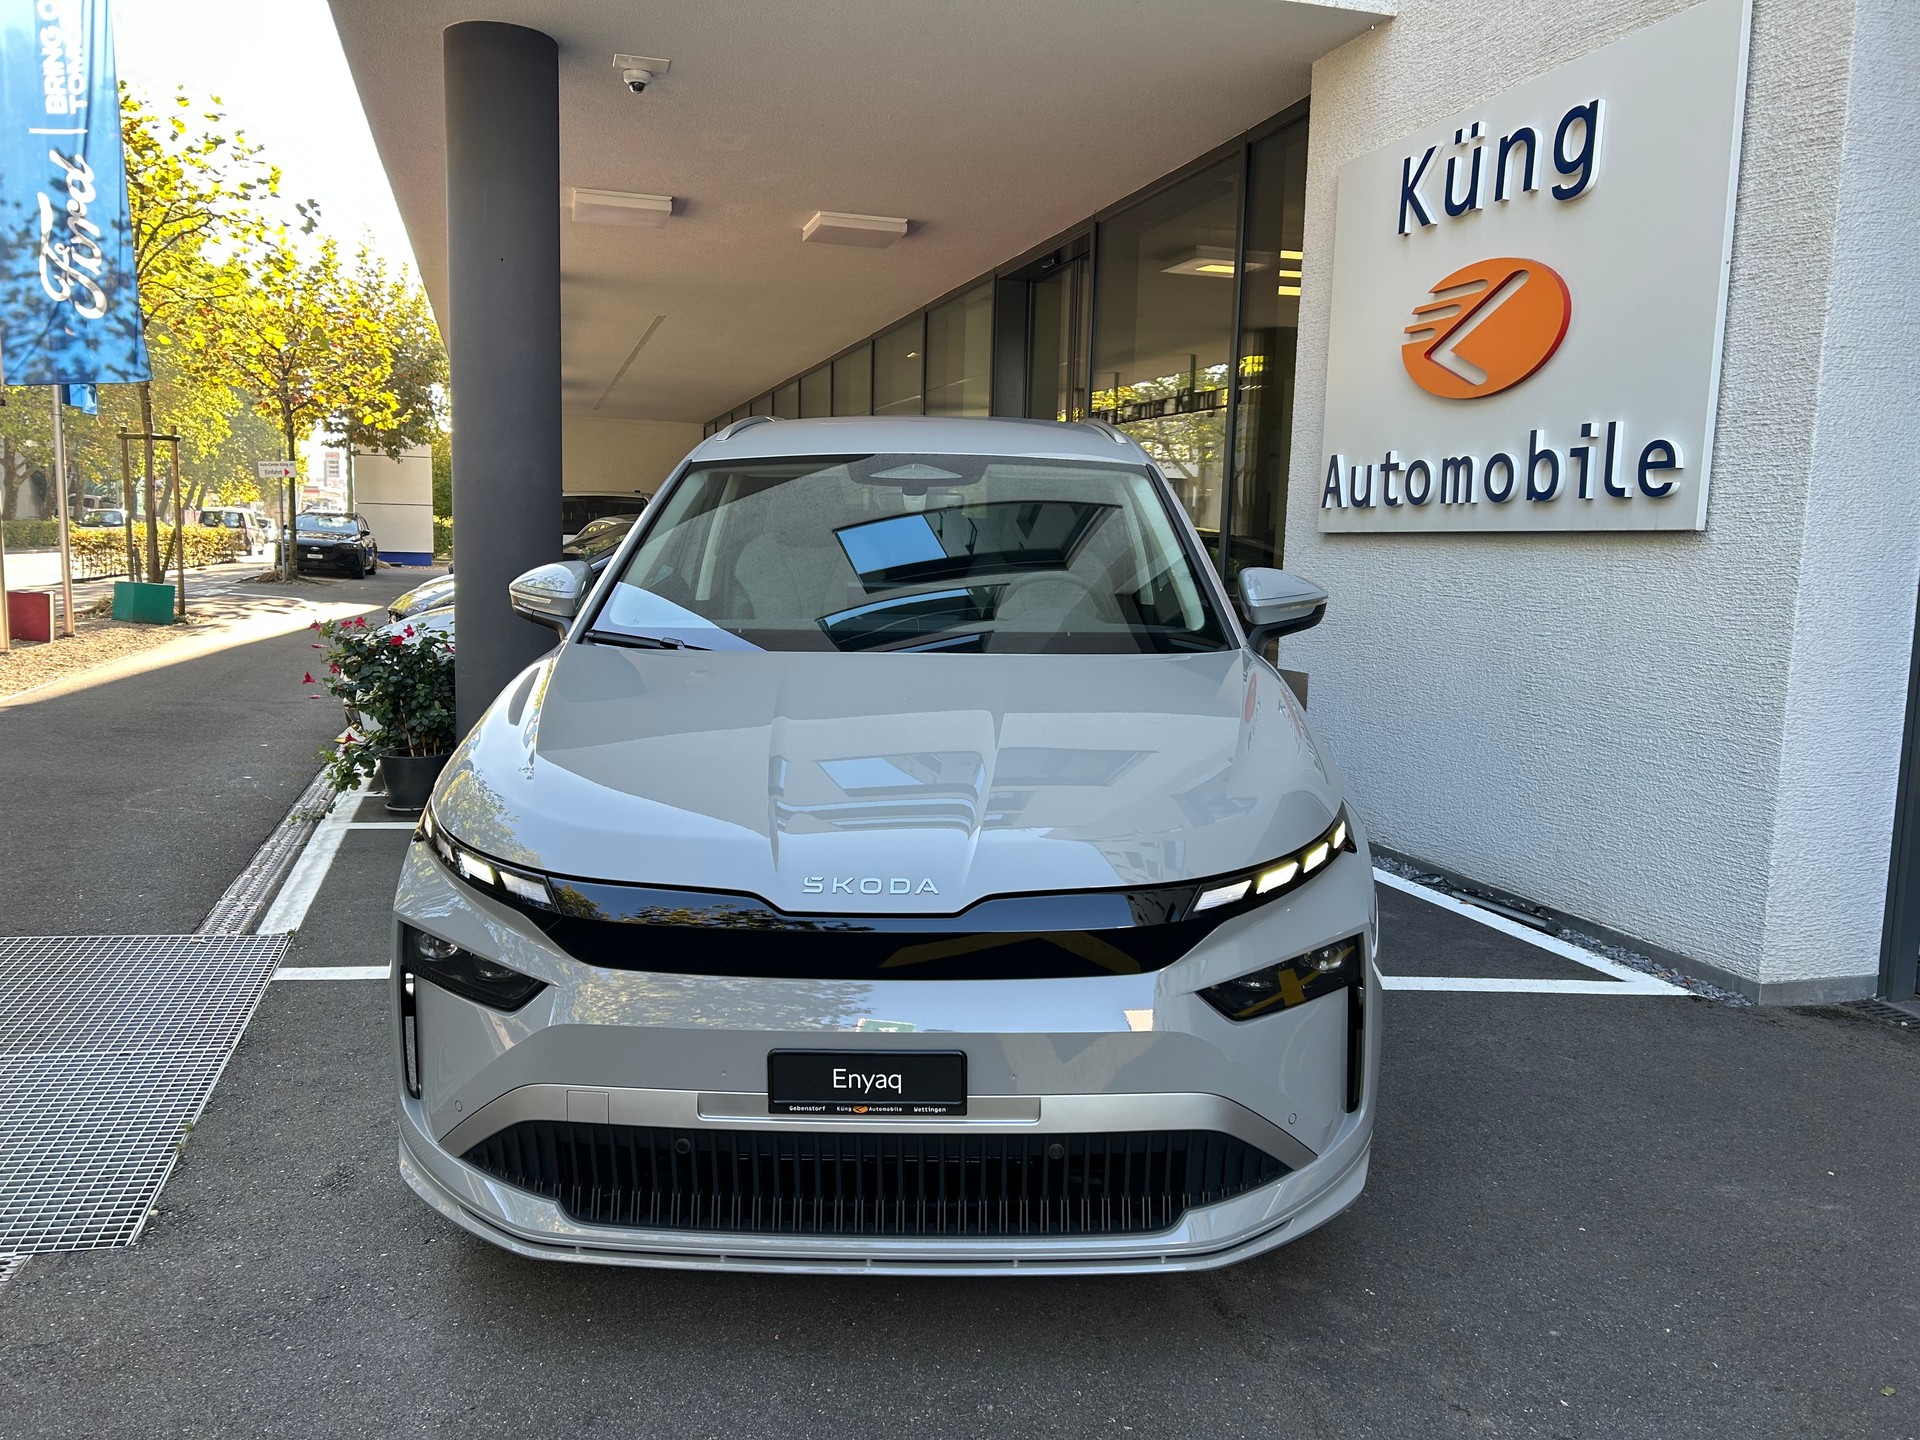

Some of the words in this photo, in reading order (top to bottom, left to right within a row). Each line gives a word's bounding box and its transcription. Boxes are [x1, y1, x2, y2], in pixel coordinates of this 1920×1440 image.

[40, 25, 68, 114] BRING
[1398, 99, 1605, 235] Küng
[37, 149, 107, 319] Ford
[1321, 421, 1684, 509] Automobile
[833, 1068, 901, 1094] Enyaq
[836, 1105, 852, 1113] Küng
